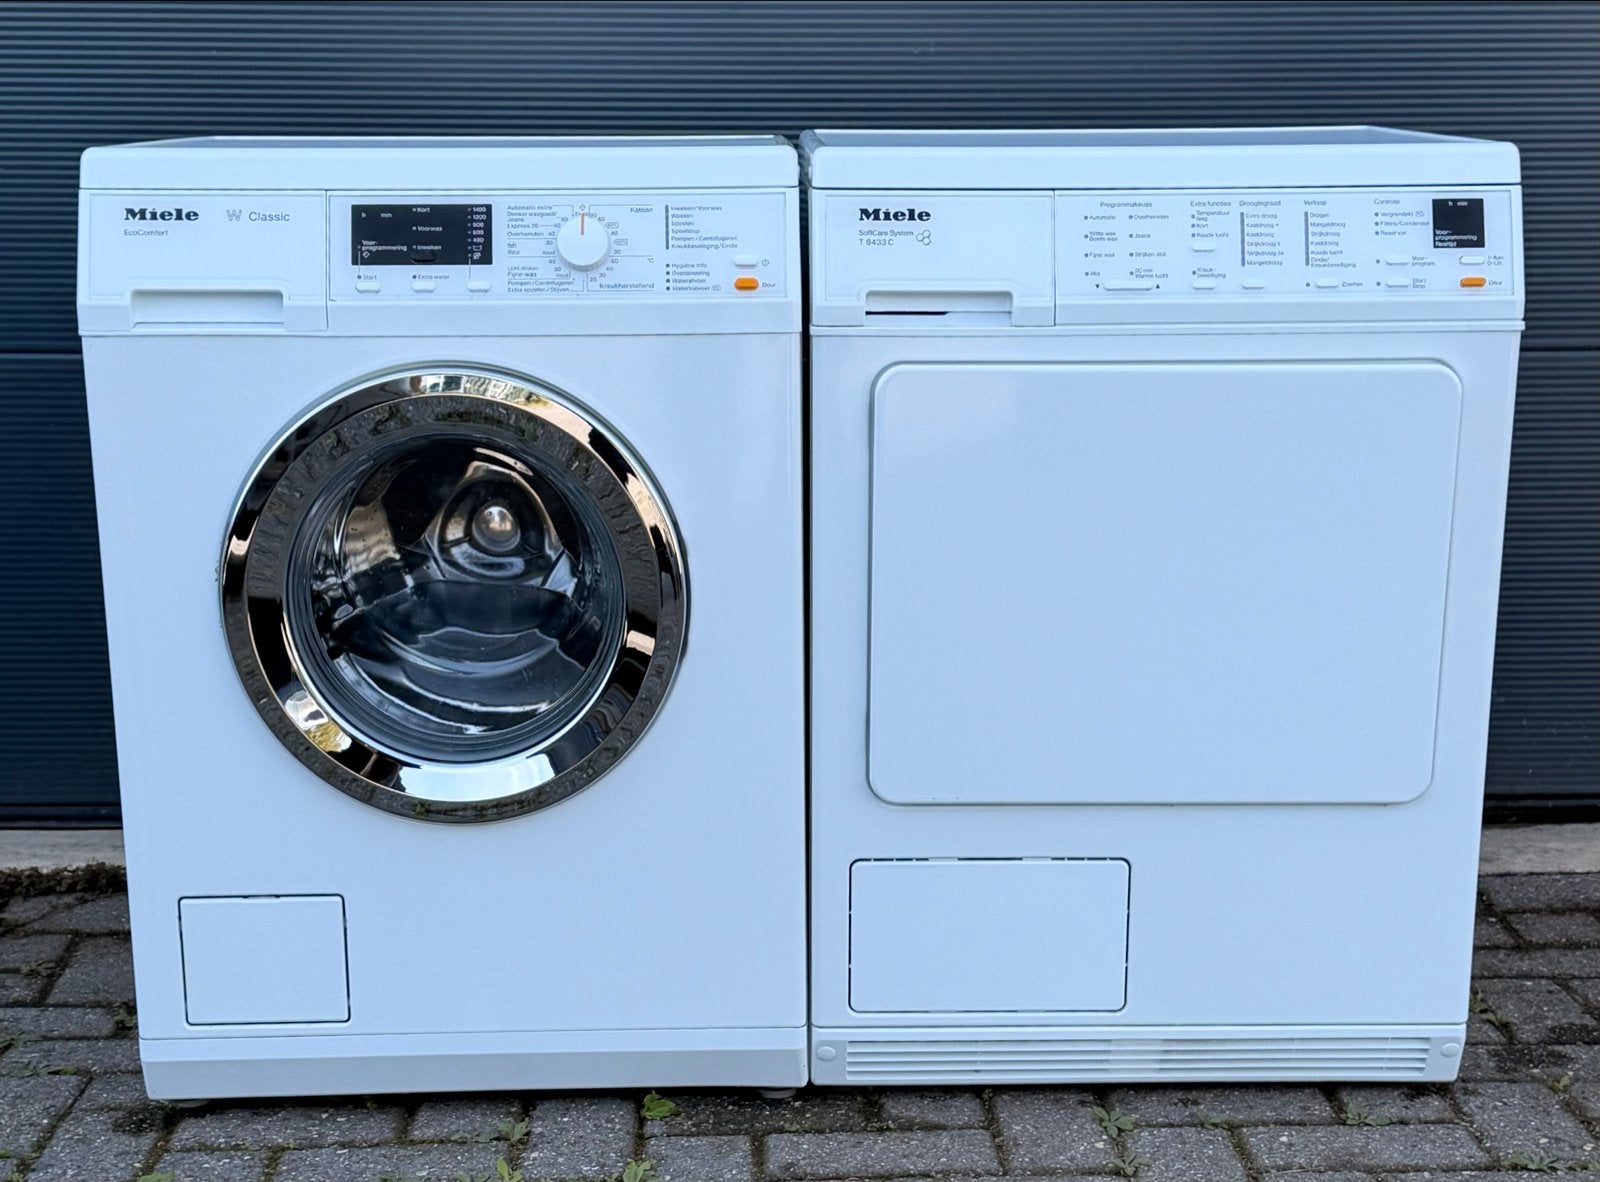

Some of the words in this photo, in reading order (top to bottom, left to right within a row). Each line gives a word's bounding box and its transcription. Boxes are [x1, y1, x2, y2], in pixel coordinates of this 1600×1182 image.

[124, 208, 199, 221] Miele
[226, 209, 242, 221] W
[249, 211, 290, 222] Classic
[859, 208, 931, 221] Miele
[890, 229, 914, 237] System
